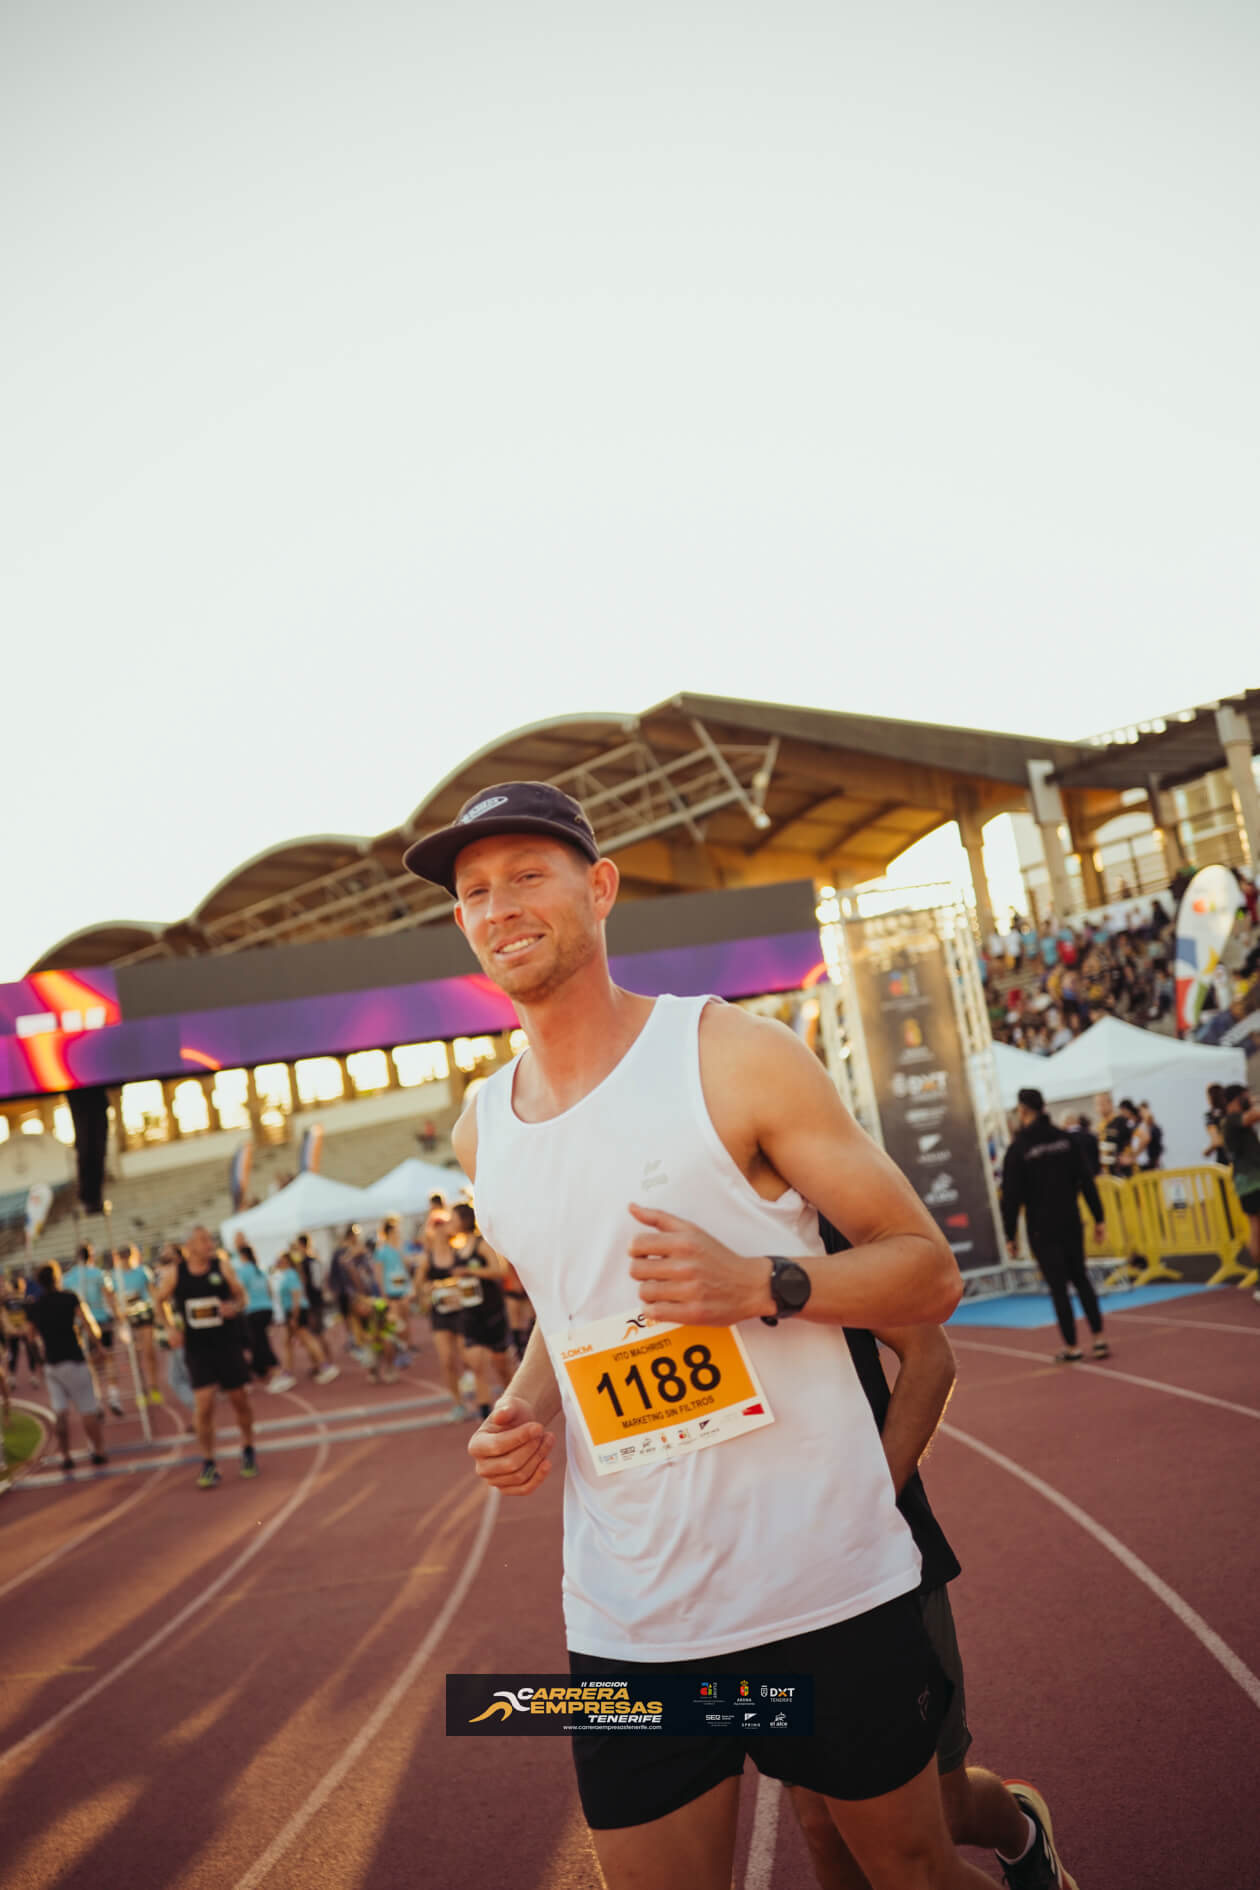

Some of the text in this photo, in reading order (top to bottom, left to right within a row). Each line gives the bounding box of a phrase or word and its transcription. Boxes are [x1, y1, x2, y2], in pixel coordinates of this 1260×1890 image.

[613, 1350, 630, 1362] VITO
[596, 1344, 721, 1417] 1188
[622, 1394, 715, 1428] MARKETING SIN FILTROS
